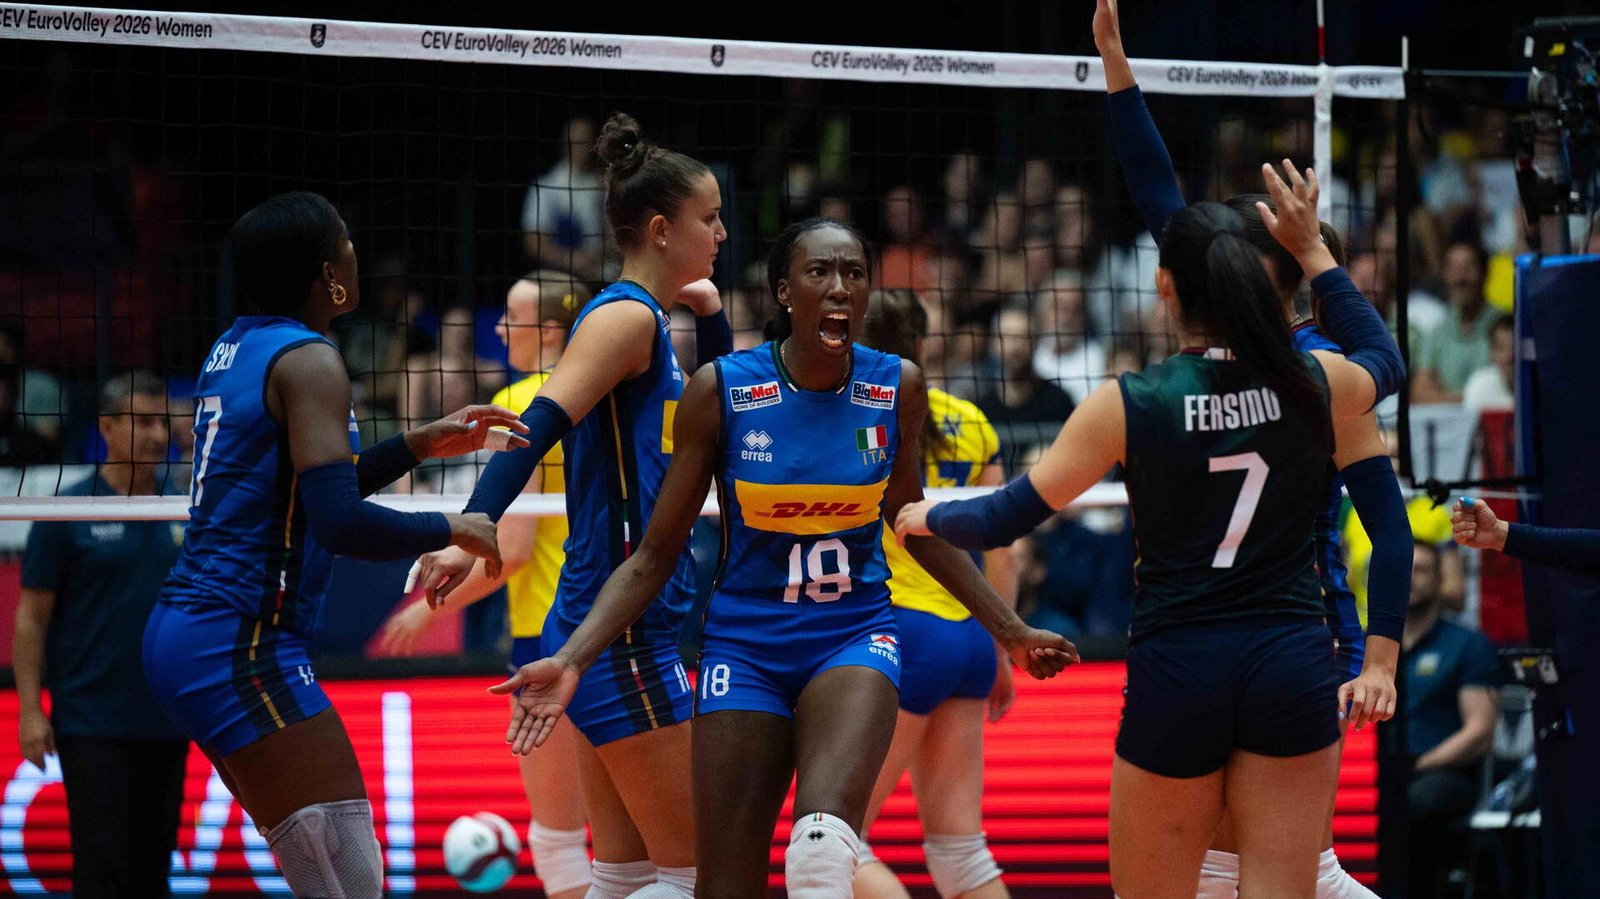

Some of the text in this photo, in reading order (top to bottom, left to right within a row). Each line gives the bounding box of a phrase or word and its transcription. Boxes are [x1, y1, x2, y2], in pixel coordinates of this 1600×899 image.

[0, 8, 213, 38] EV EuroVolley 2026 Women
[421, 30, 622, 58] CEV EuroVolley 2026 Women
[811, 51, 995, 75] CEV EuroVolley 2026 Women
[1167, 66, 1194, 83] CEV
[730, 384, 778, 403] BigMat
[853, 382, 894, 400] BigMat
[1184, 387, 1281, 432] FERSINO
[863, 448, 887, 466] ITA
[769, 501, 865, 519] DHL
[1209, 452, 1270, 568] 7
[783, 538, 853, 604] 18
[702, 664, 731, 700] 18
